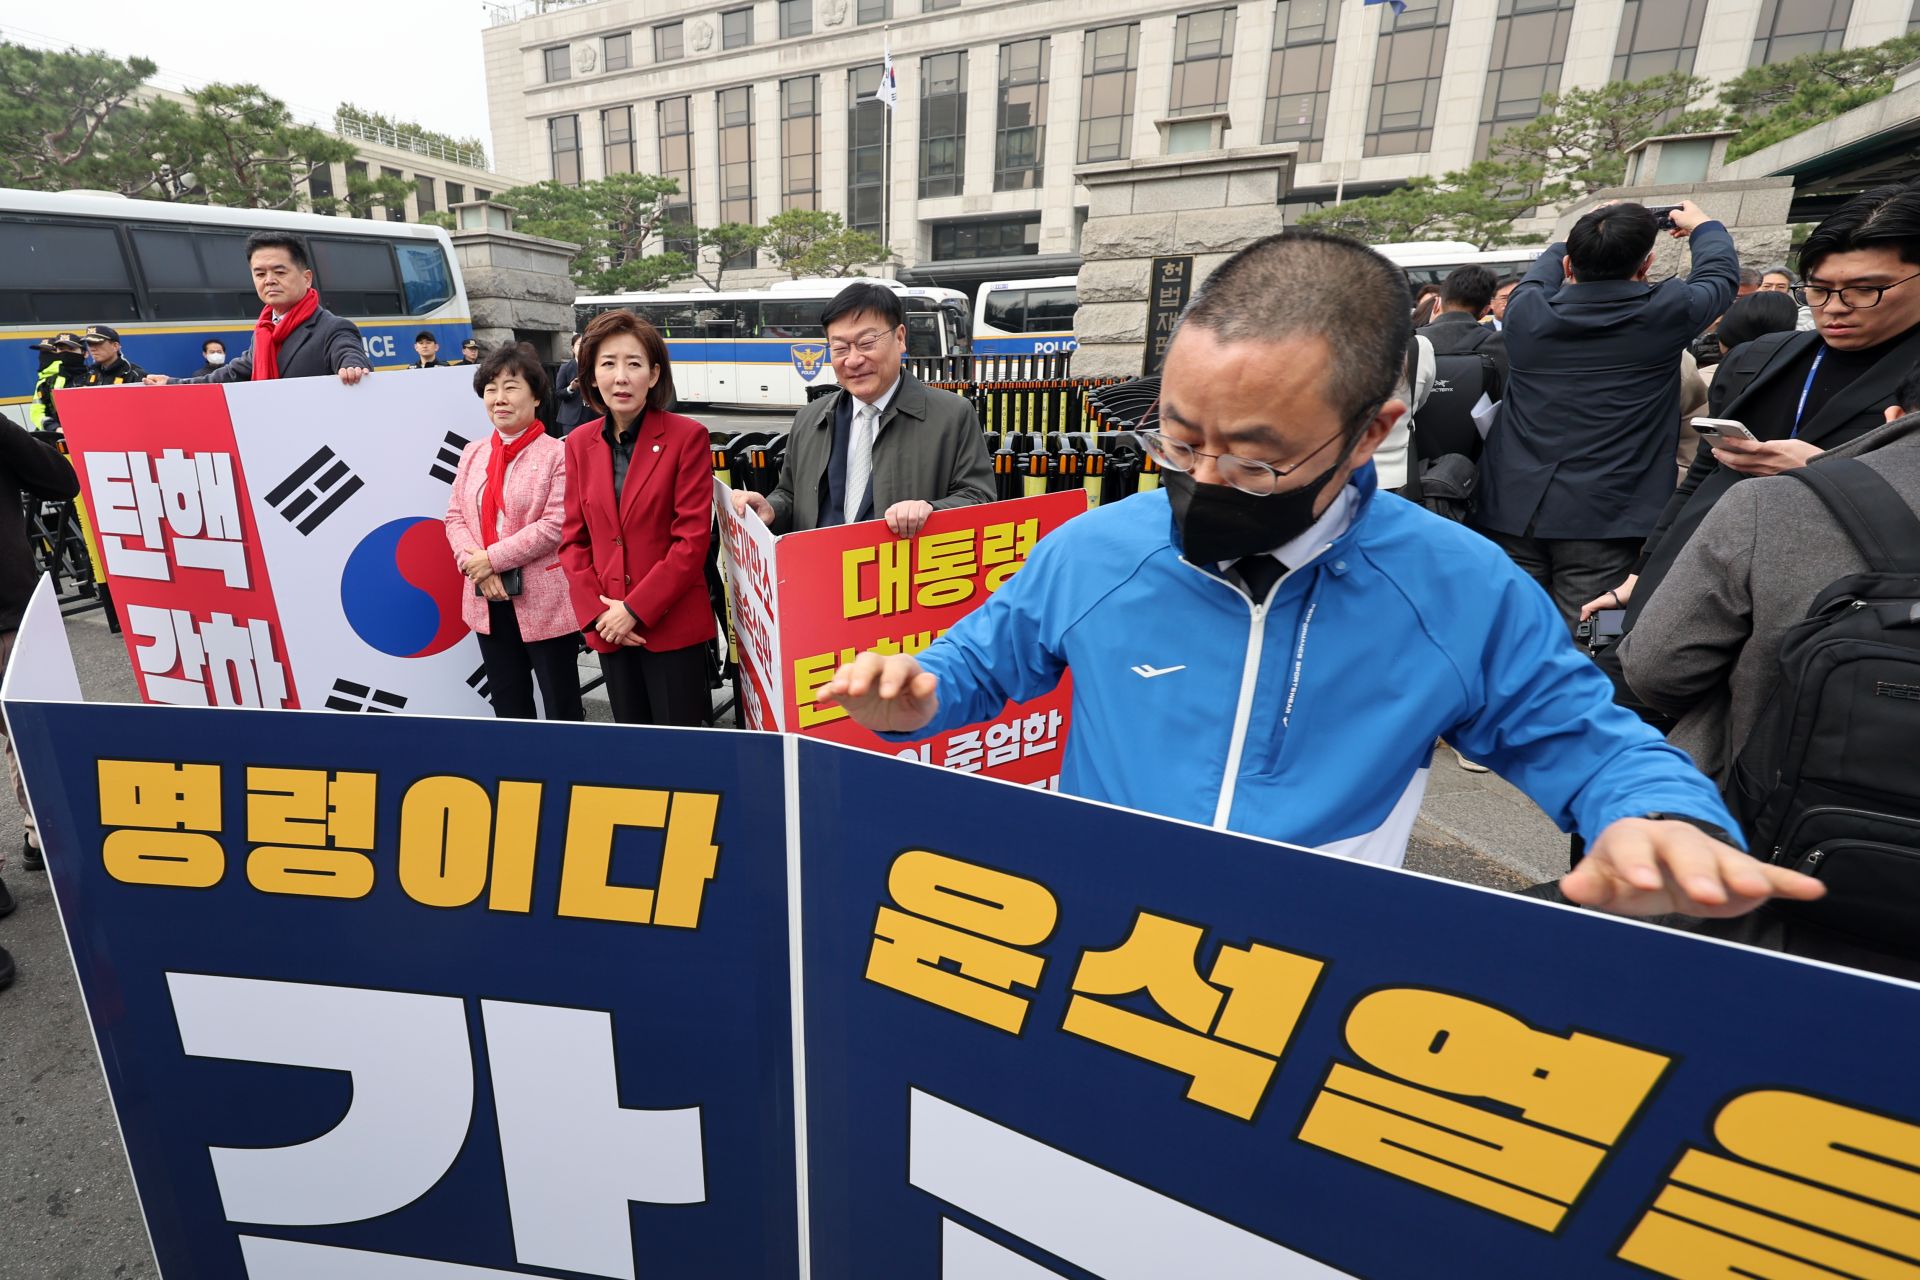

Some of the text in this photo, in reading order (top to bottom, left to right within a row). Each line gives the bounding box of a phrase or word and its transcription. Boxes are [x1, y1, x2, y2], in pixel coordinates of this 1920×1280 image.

[1034, 340, 1080, 354] POLIC
[1153, 261, 1184, 372] 헌법재
[83, 448, 250, 589] 탄핵
[716, 502, 775, 626] 헌법재판소
[842, 518, 1039, 618] 대통령
[944, 709, 1062, 773] 준엄한
[97, 759, 721, 929] 명령이다
